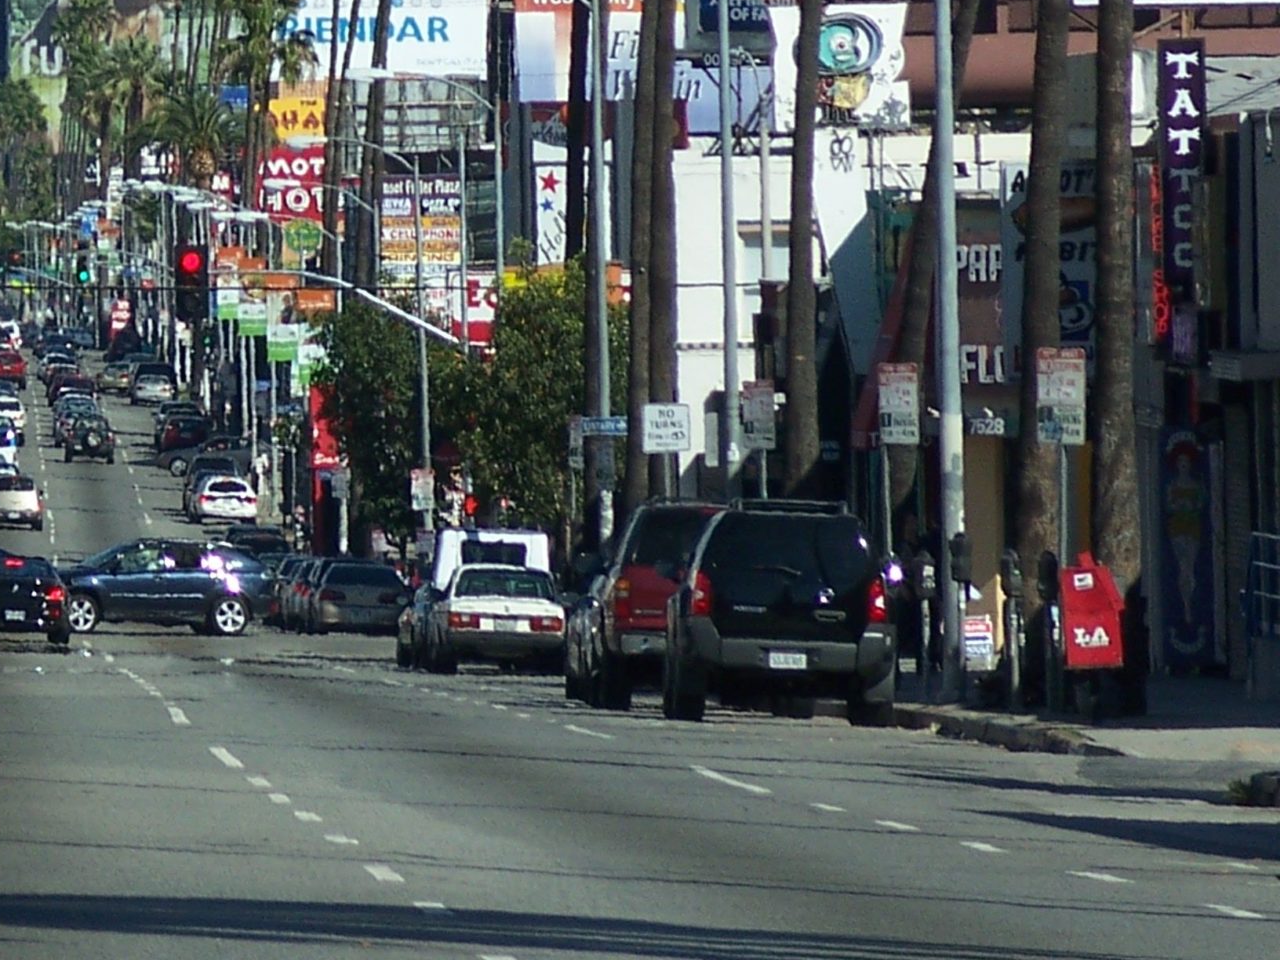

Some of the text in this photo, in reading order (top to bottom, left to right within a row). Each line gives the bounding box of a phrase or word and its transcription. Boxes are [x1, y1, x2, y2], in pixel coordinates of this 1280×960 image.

[729, 8, 769, 21] OF FA
[658, 408, 676, 419] NO
[1073, 626, 1111, 647] LA
